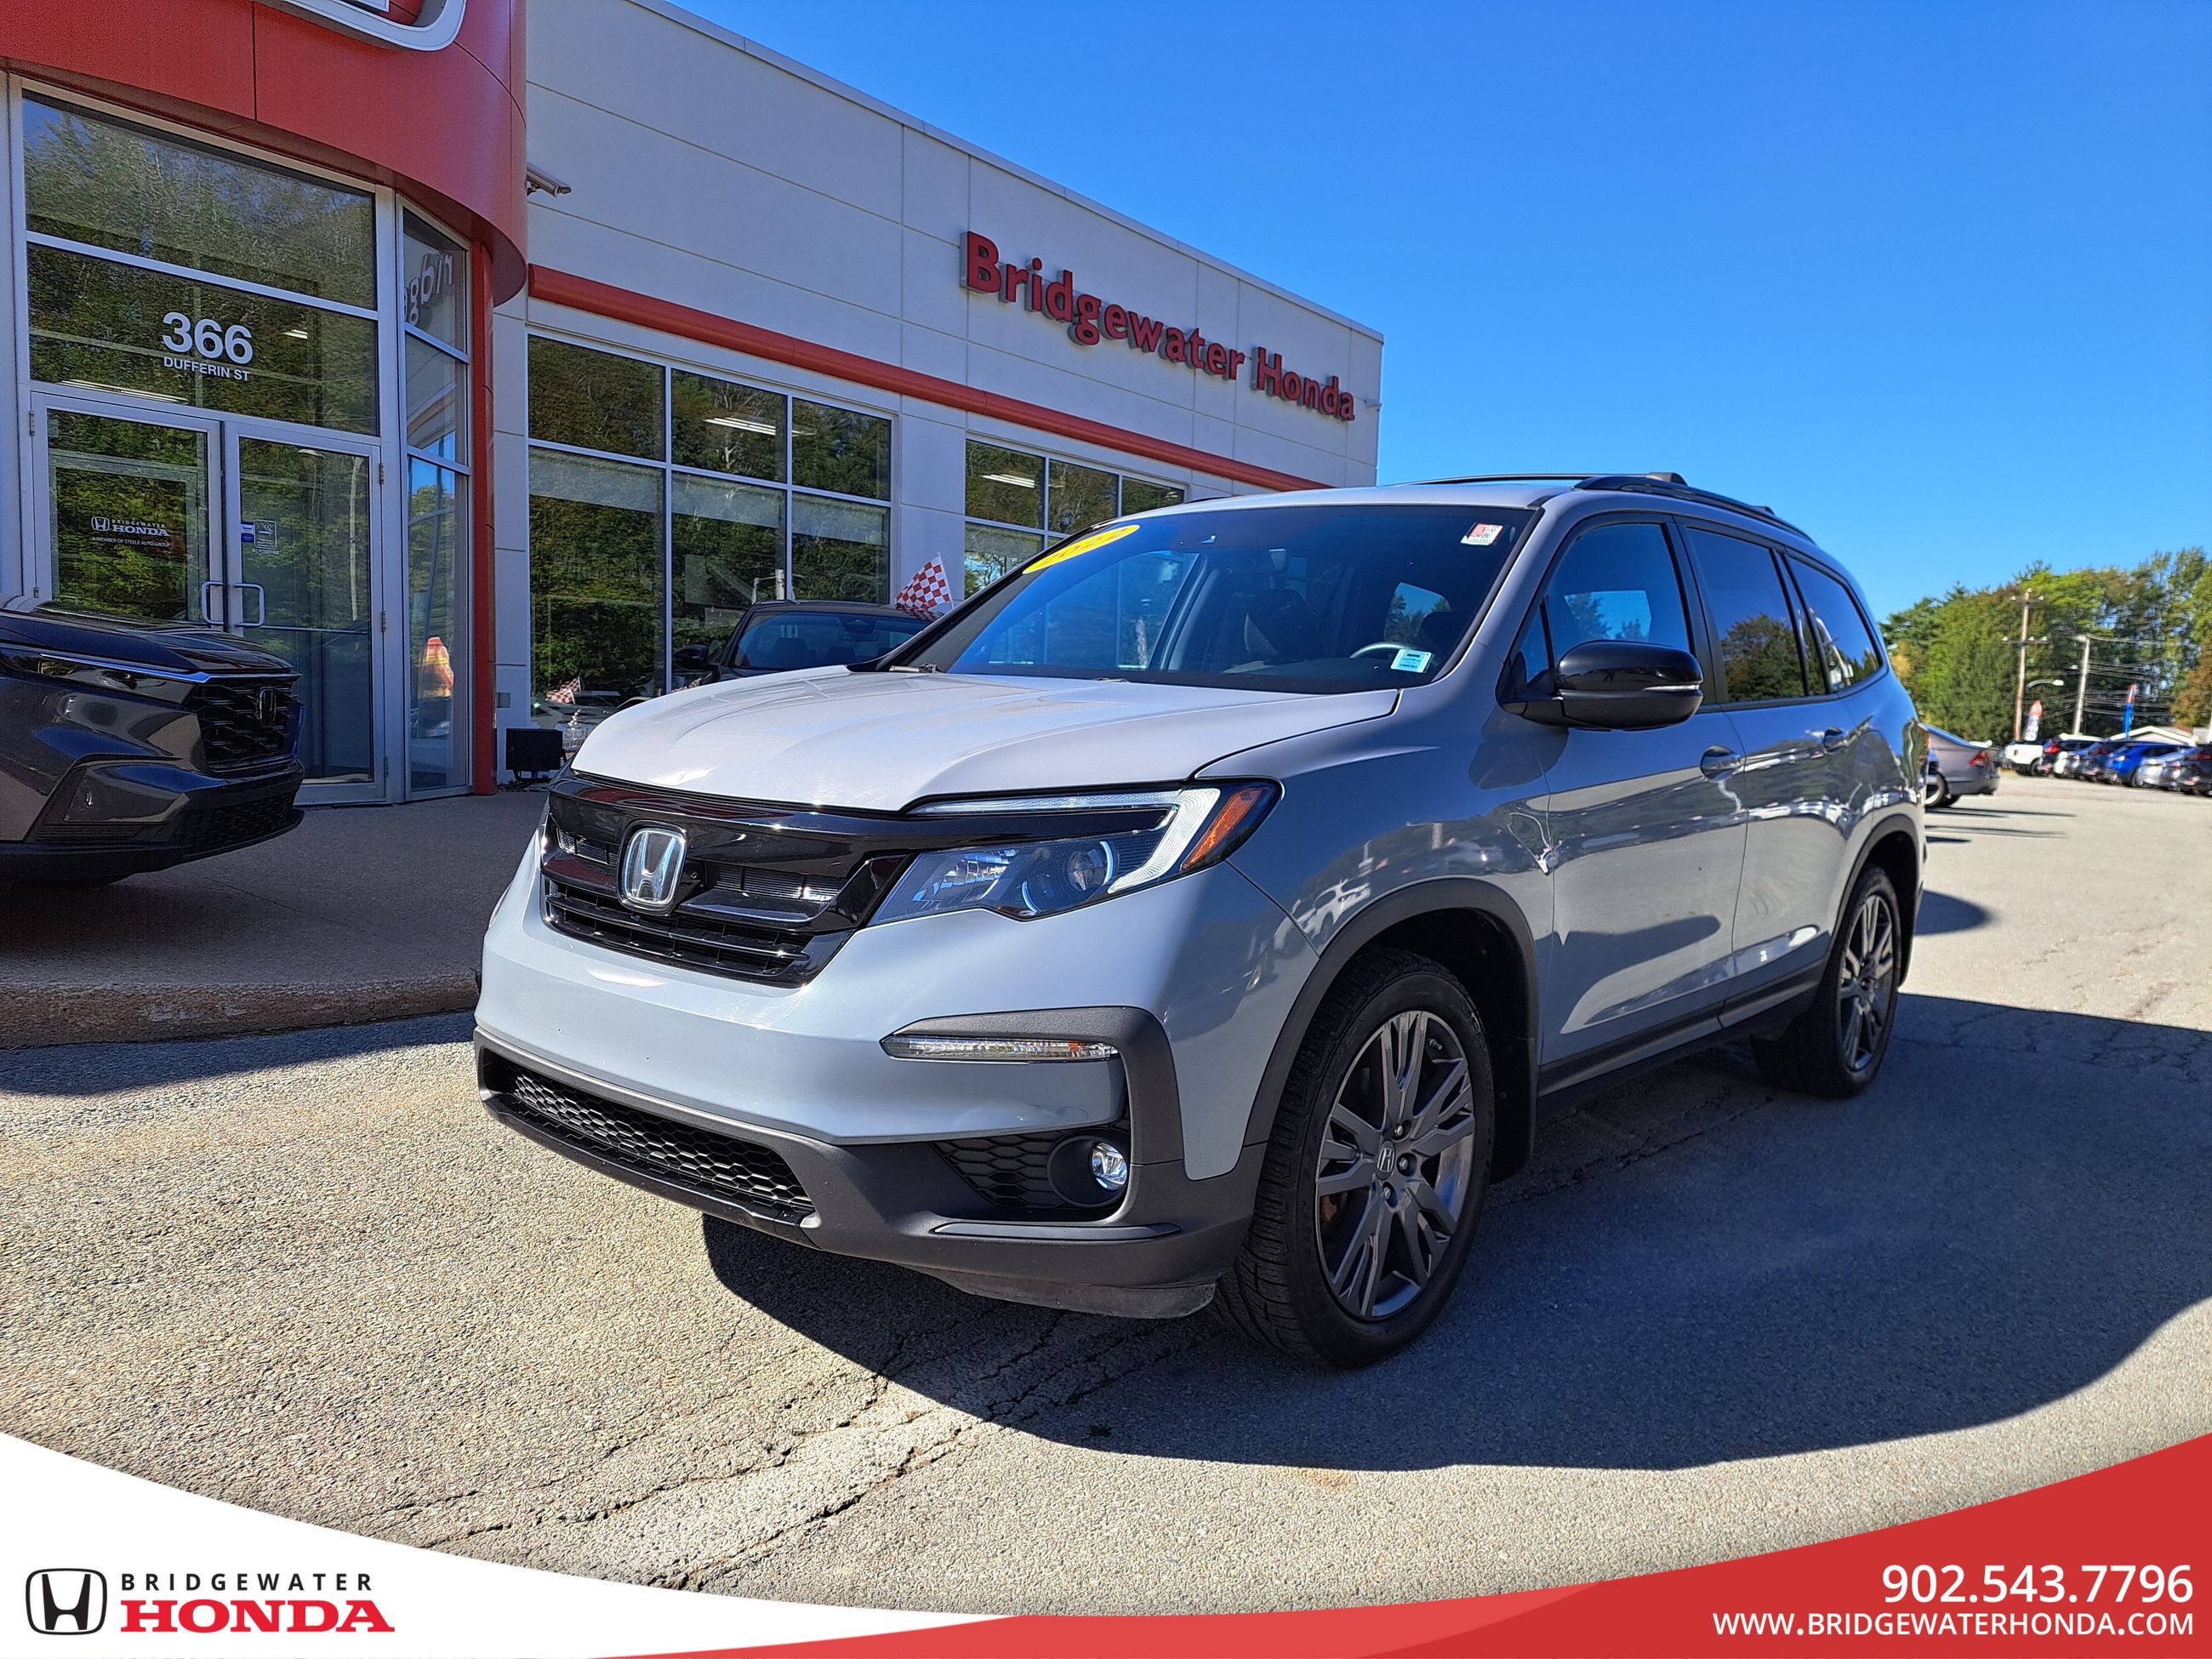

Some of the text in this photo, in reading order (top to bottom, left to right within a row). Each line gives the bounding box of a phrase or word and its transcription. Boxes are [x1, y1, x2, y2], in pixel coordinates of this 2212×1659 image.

[162, 311, 254, 364] 366
[961, 231, 1355, 422] Bridgewater Honda
[163, 356, 251, 381] DUFFERIN ST
[111, 519, 167, 529] BRIDGEWATER
[111, 524, 171, 537] HONDA
